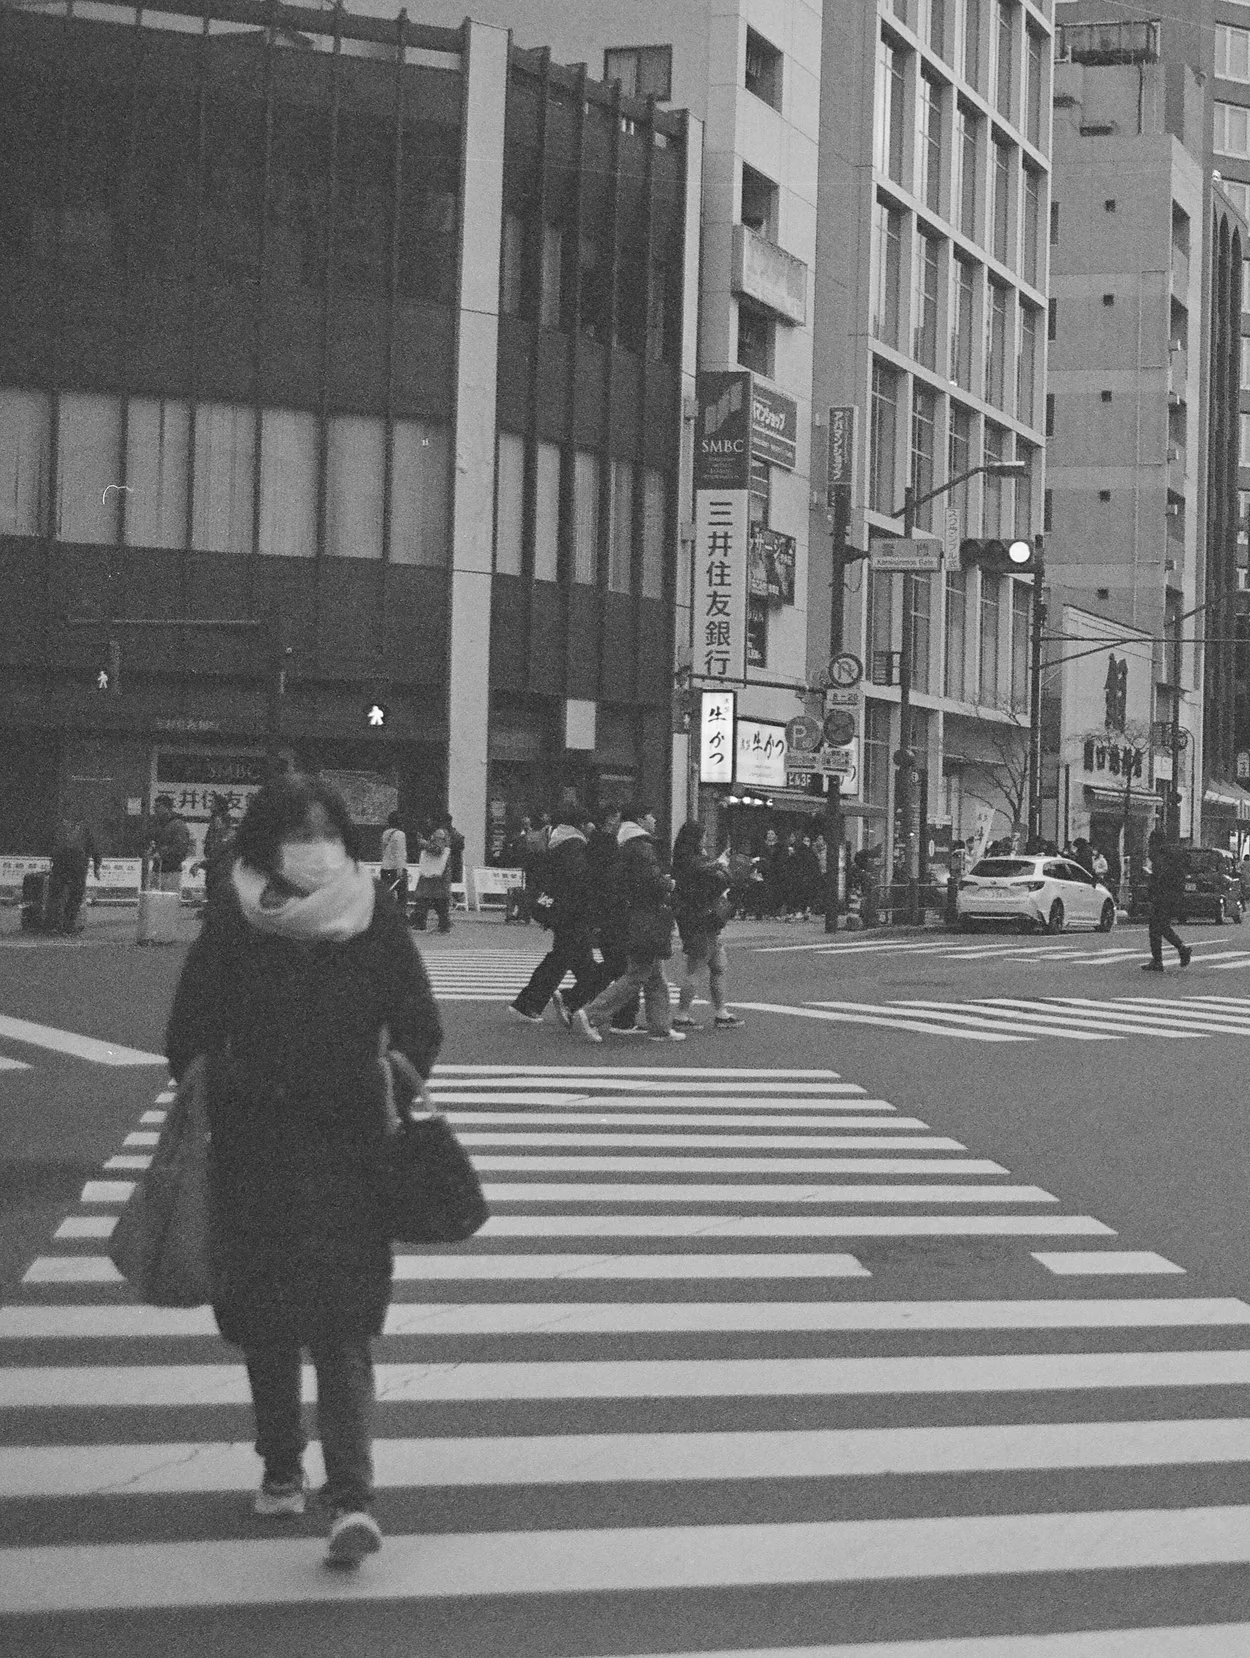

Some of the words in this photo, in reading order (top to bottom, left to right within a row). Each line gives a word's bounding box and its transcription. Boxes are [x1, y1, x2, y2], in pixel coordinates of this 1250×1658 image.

[701, 439, 744, 453] SMBC
[704, 501, 734, 676] 三井住友銀行
[157, 789, 257, 810] 井住友
